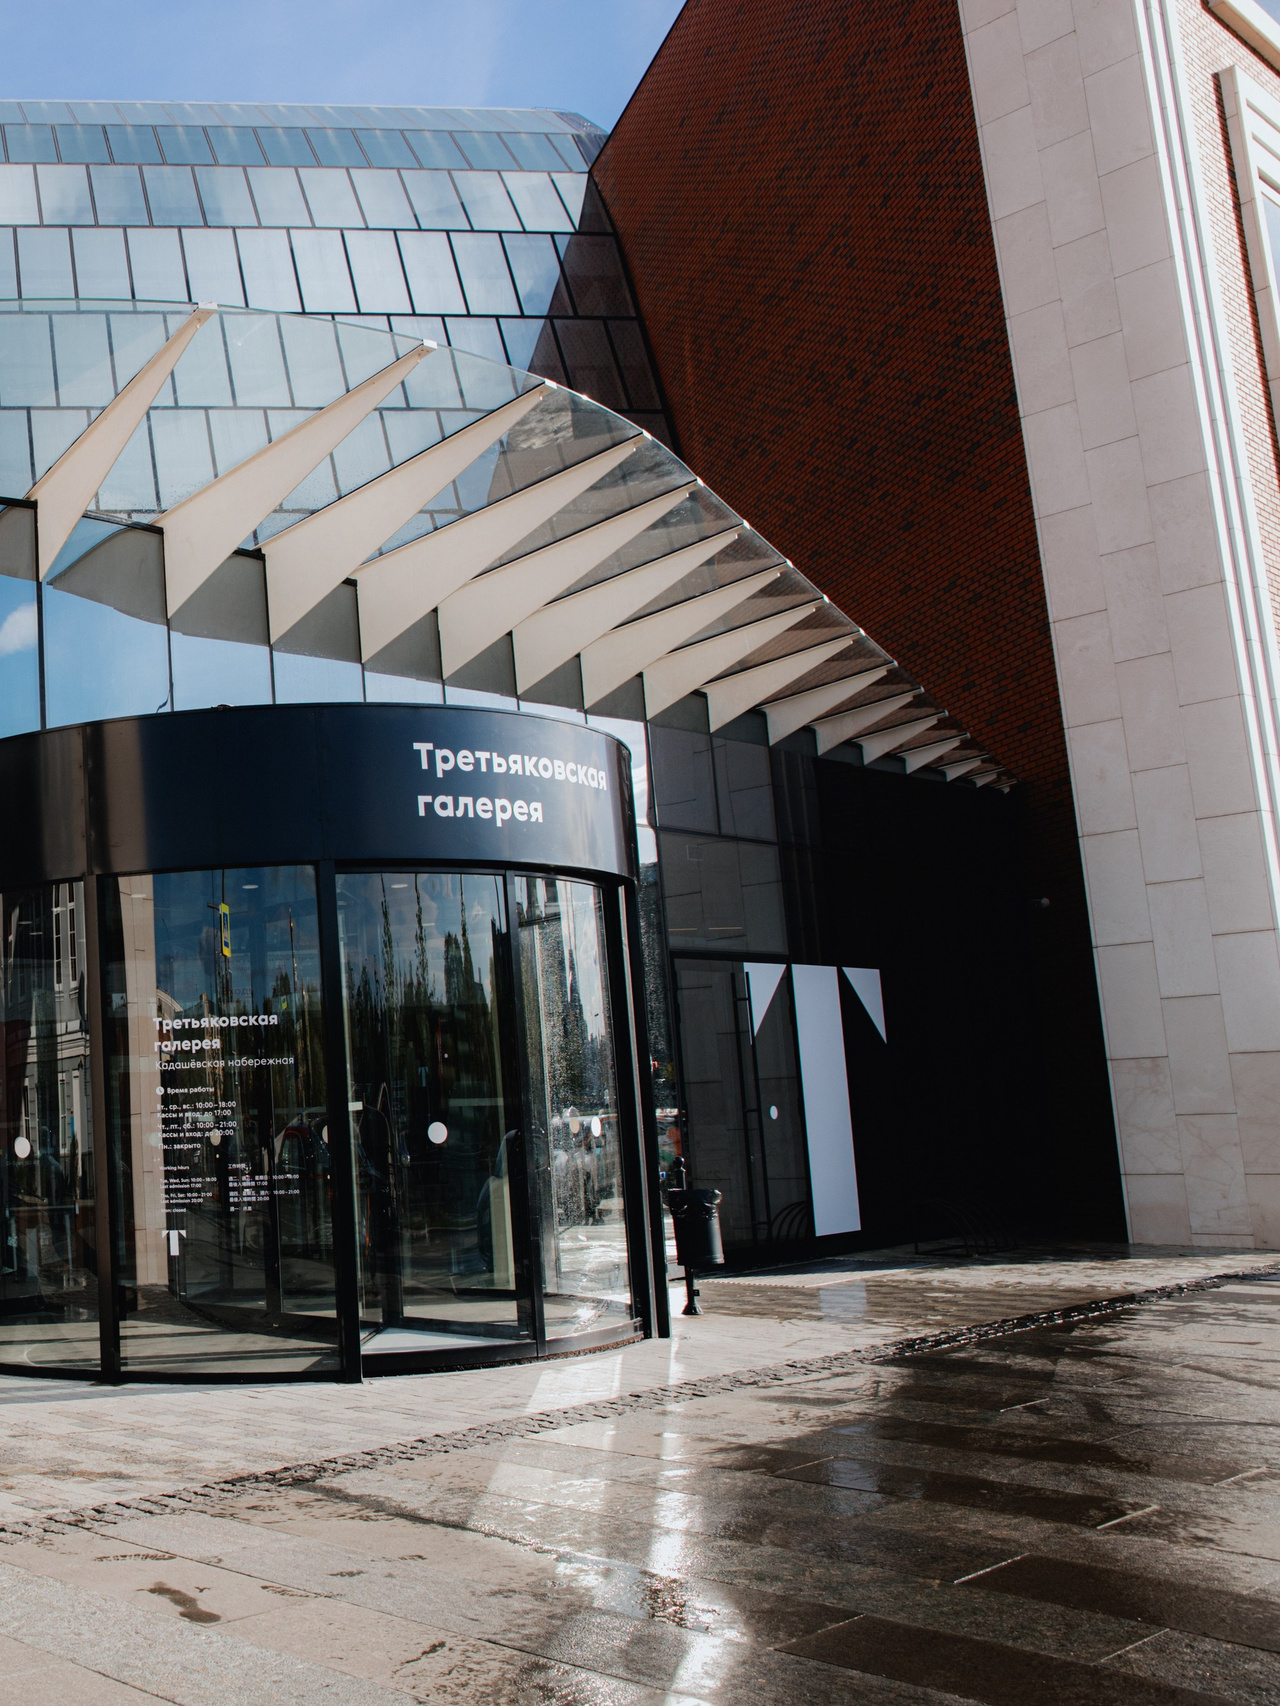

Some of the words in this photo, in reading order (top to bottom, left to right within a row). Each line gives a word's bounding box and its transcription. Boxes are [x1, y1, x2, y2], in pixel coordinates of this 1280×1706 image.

[413, 742, 607, 791] Третьяковская
[417, 794, 544, 827] галерея
[152, 1014, 278, 1033] Третьяковская
[154, 1038, 221, 1053] галерея
[155, 1059, 225, 1070] Кадашёвская
[228, 1056, 295, 1068] набережная
[167, 1087, 188, 1095] Время
[189, 1086, 215, 1094] работы
